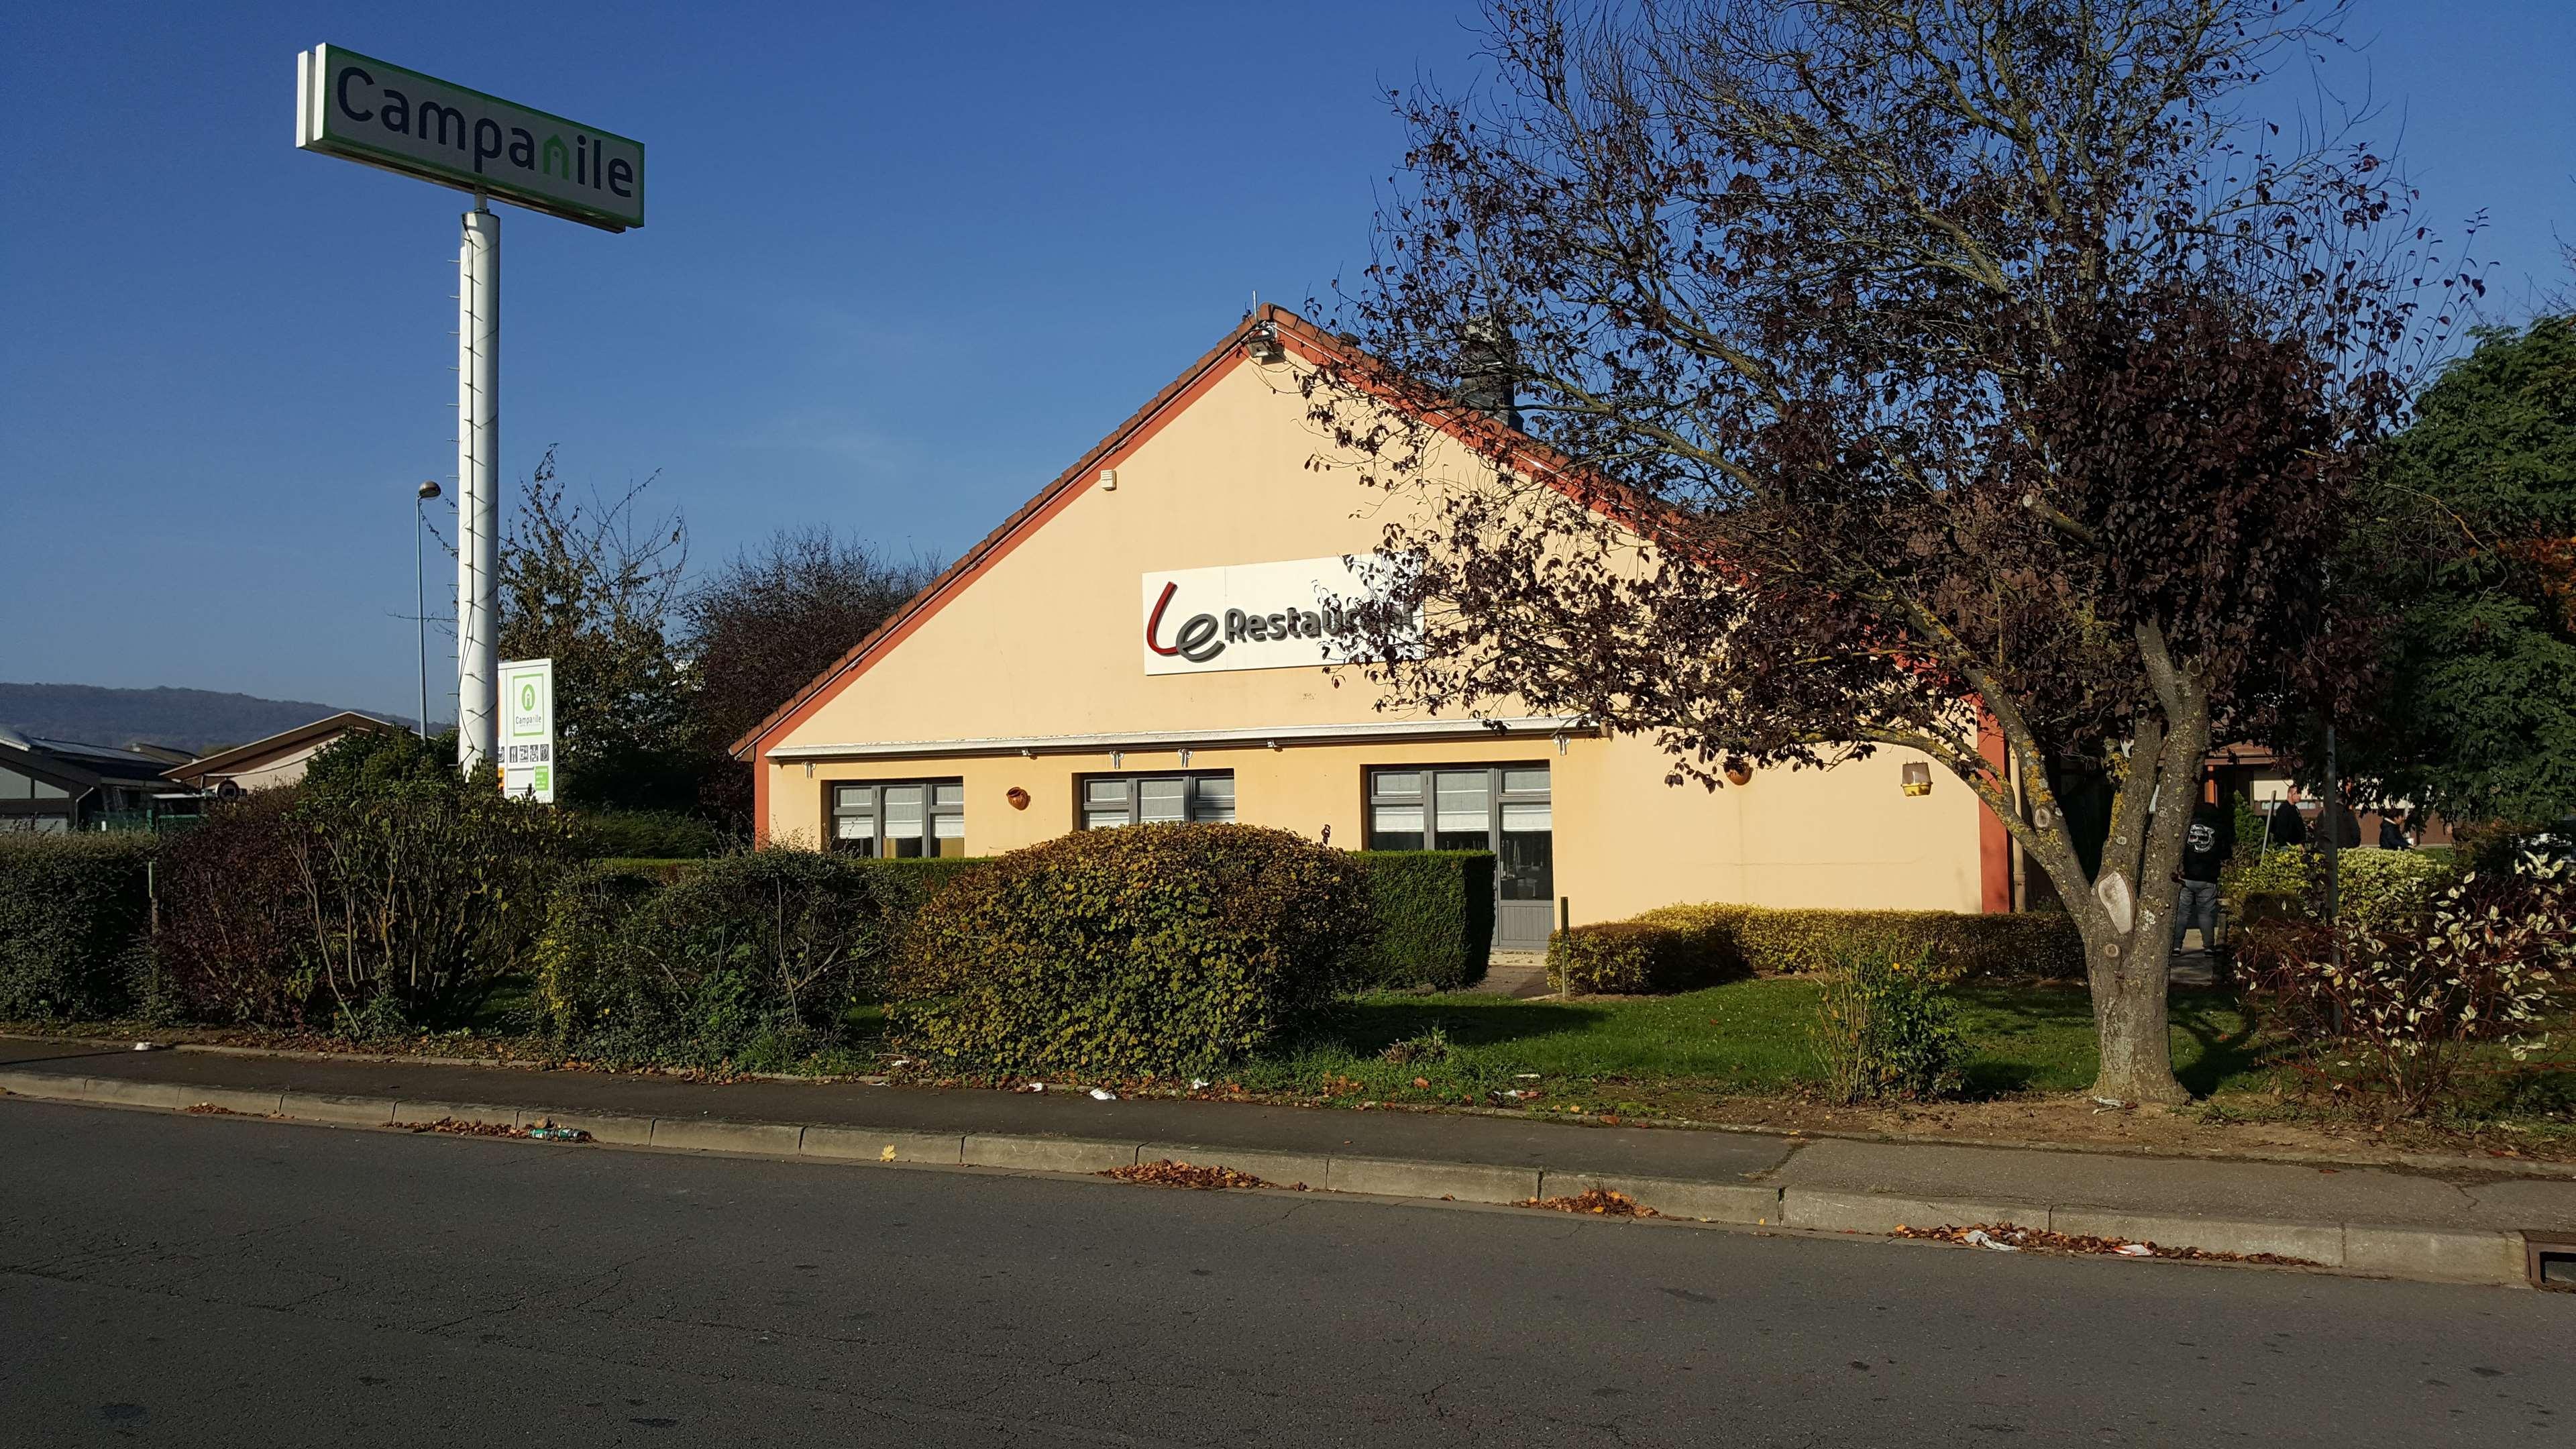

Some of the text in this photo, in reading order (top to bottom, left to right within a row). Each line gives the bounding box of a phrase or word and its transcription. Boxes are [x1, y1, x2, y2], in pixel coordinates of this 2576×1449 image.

[337, 67, 633, 197] Campanile
[1147, 582, 1418, 663] Le Restaurnt
